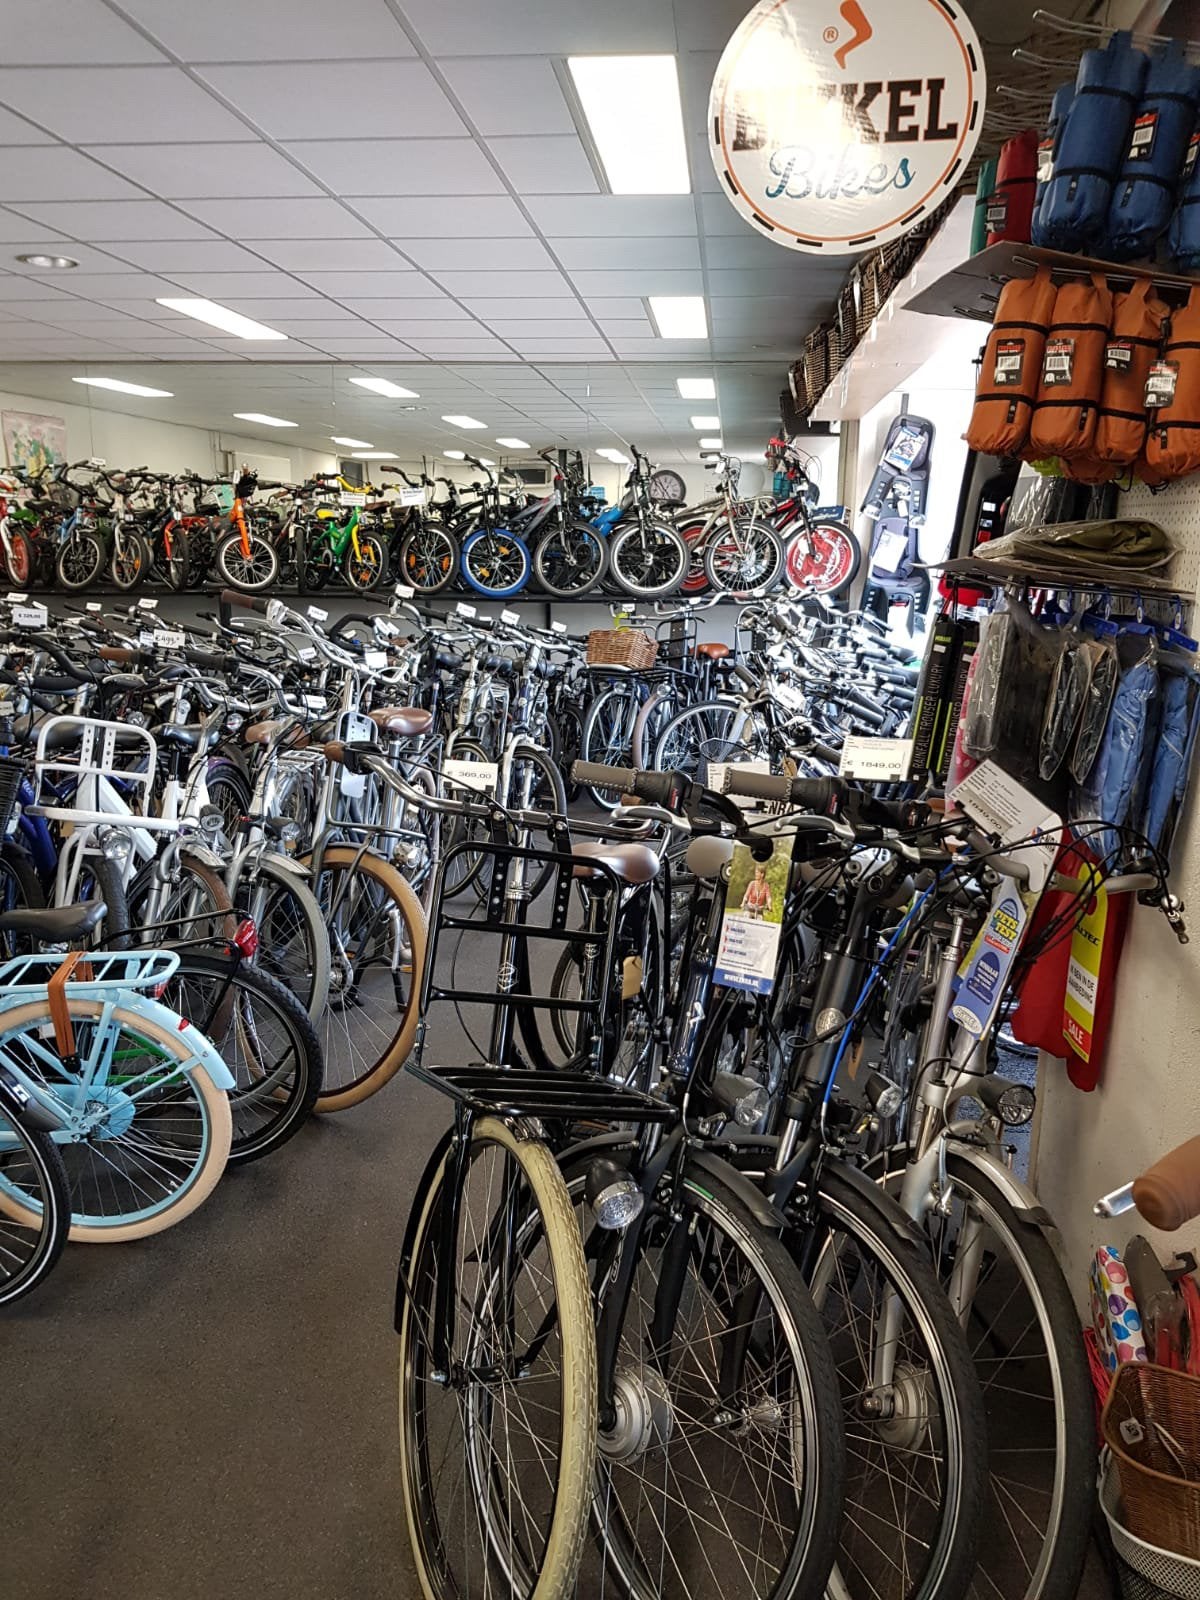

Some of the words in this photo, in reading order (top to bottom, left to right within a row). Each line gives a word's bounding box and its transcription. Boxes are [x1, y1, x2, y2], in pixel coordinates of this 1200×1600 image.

[732, 77, 959, 152] BKEL
[927, 663, 944, 694] LUXURY
[919, 696, 937, 732] TROUSER
[912, 731, 930, 769] RAINFALL
[1068, 1020, 1085, 1046] SALE
